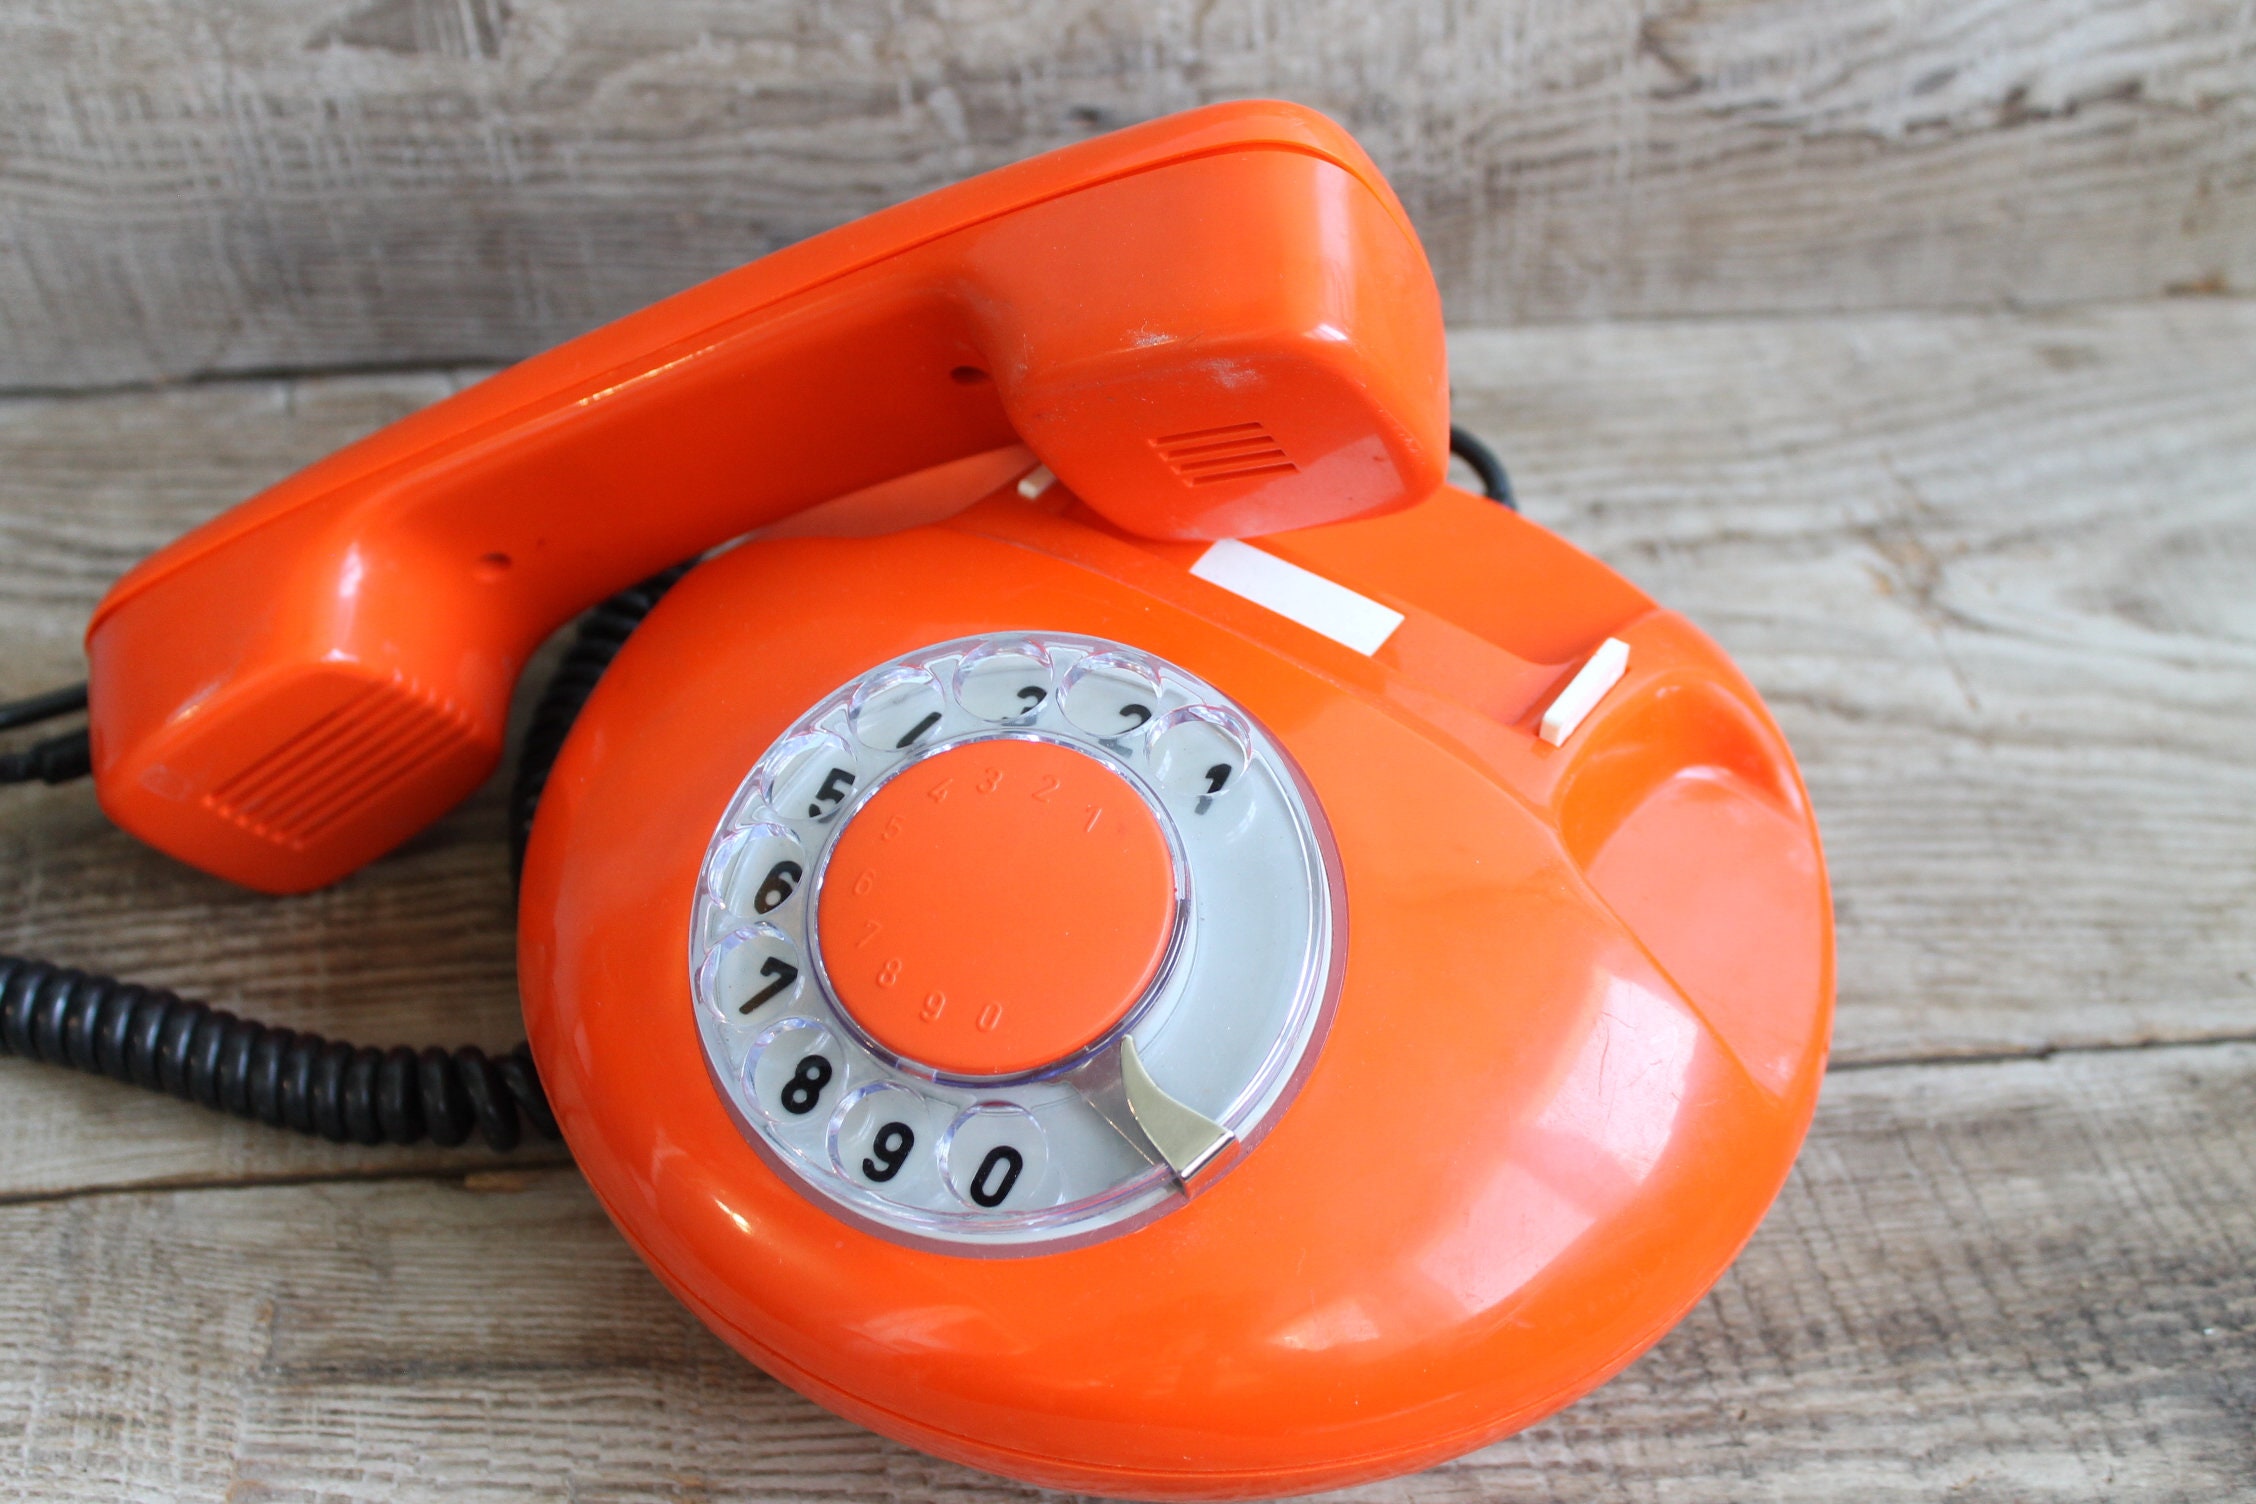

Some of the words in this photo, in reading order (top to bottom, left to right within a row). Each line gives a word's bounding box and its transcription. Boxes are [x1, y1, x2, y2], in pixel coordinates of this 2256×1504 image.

[809, 768, 856, 823] 5
[975, 766, 1004, 795] 3
[1032, 773, 1061, 803] 2
[1085, 804, 1103, 833] 1
[754, 860, 803, 915] 6
[854, 869, 878, 897] 6
[739, 956, 799, 1015] 7
[876, 956, 903, 988] 8
[919, 990, 946, 1023] 9
[976, 1002, 1003, 1033] 0
[781, 1054, 832, 1115] 8
[862, 1121, 915, 1183] 9
[970, 1145, 1023, 1208] 0
